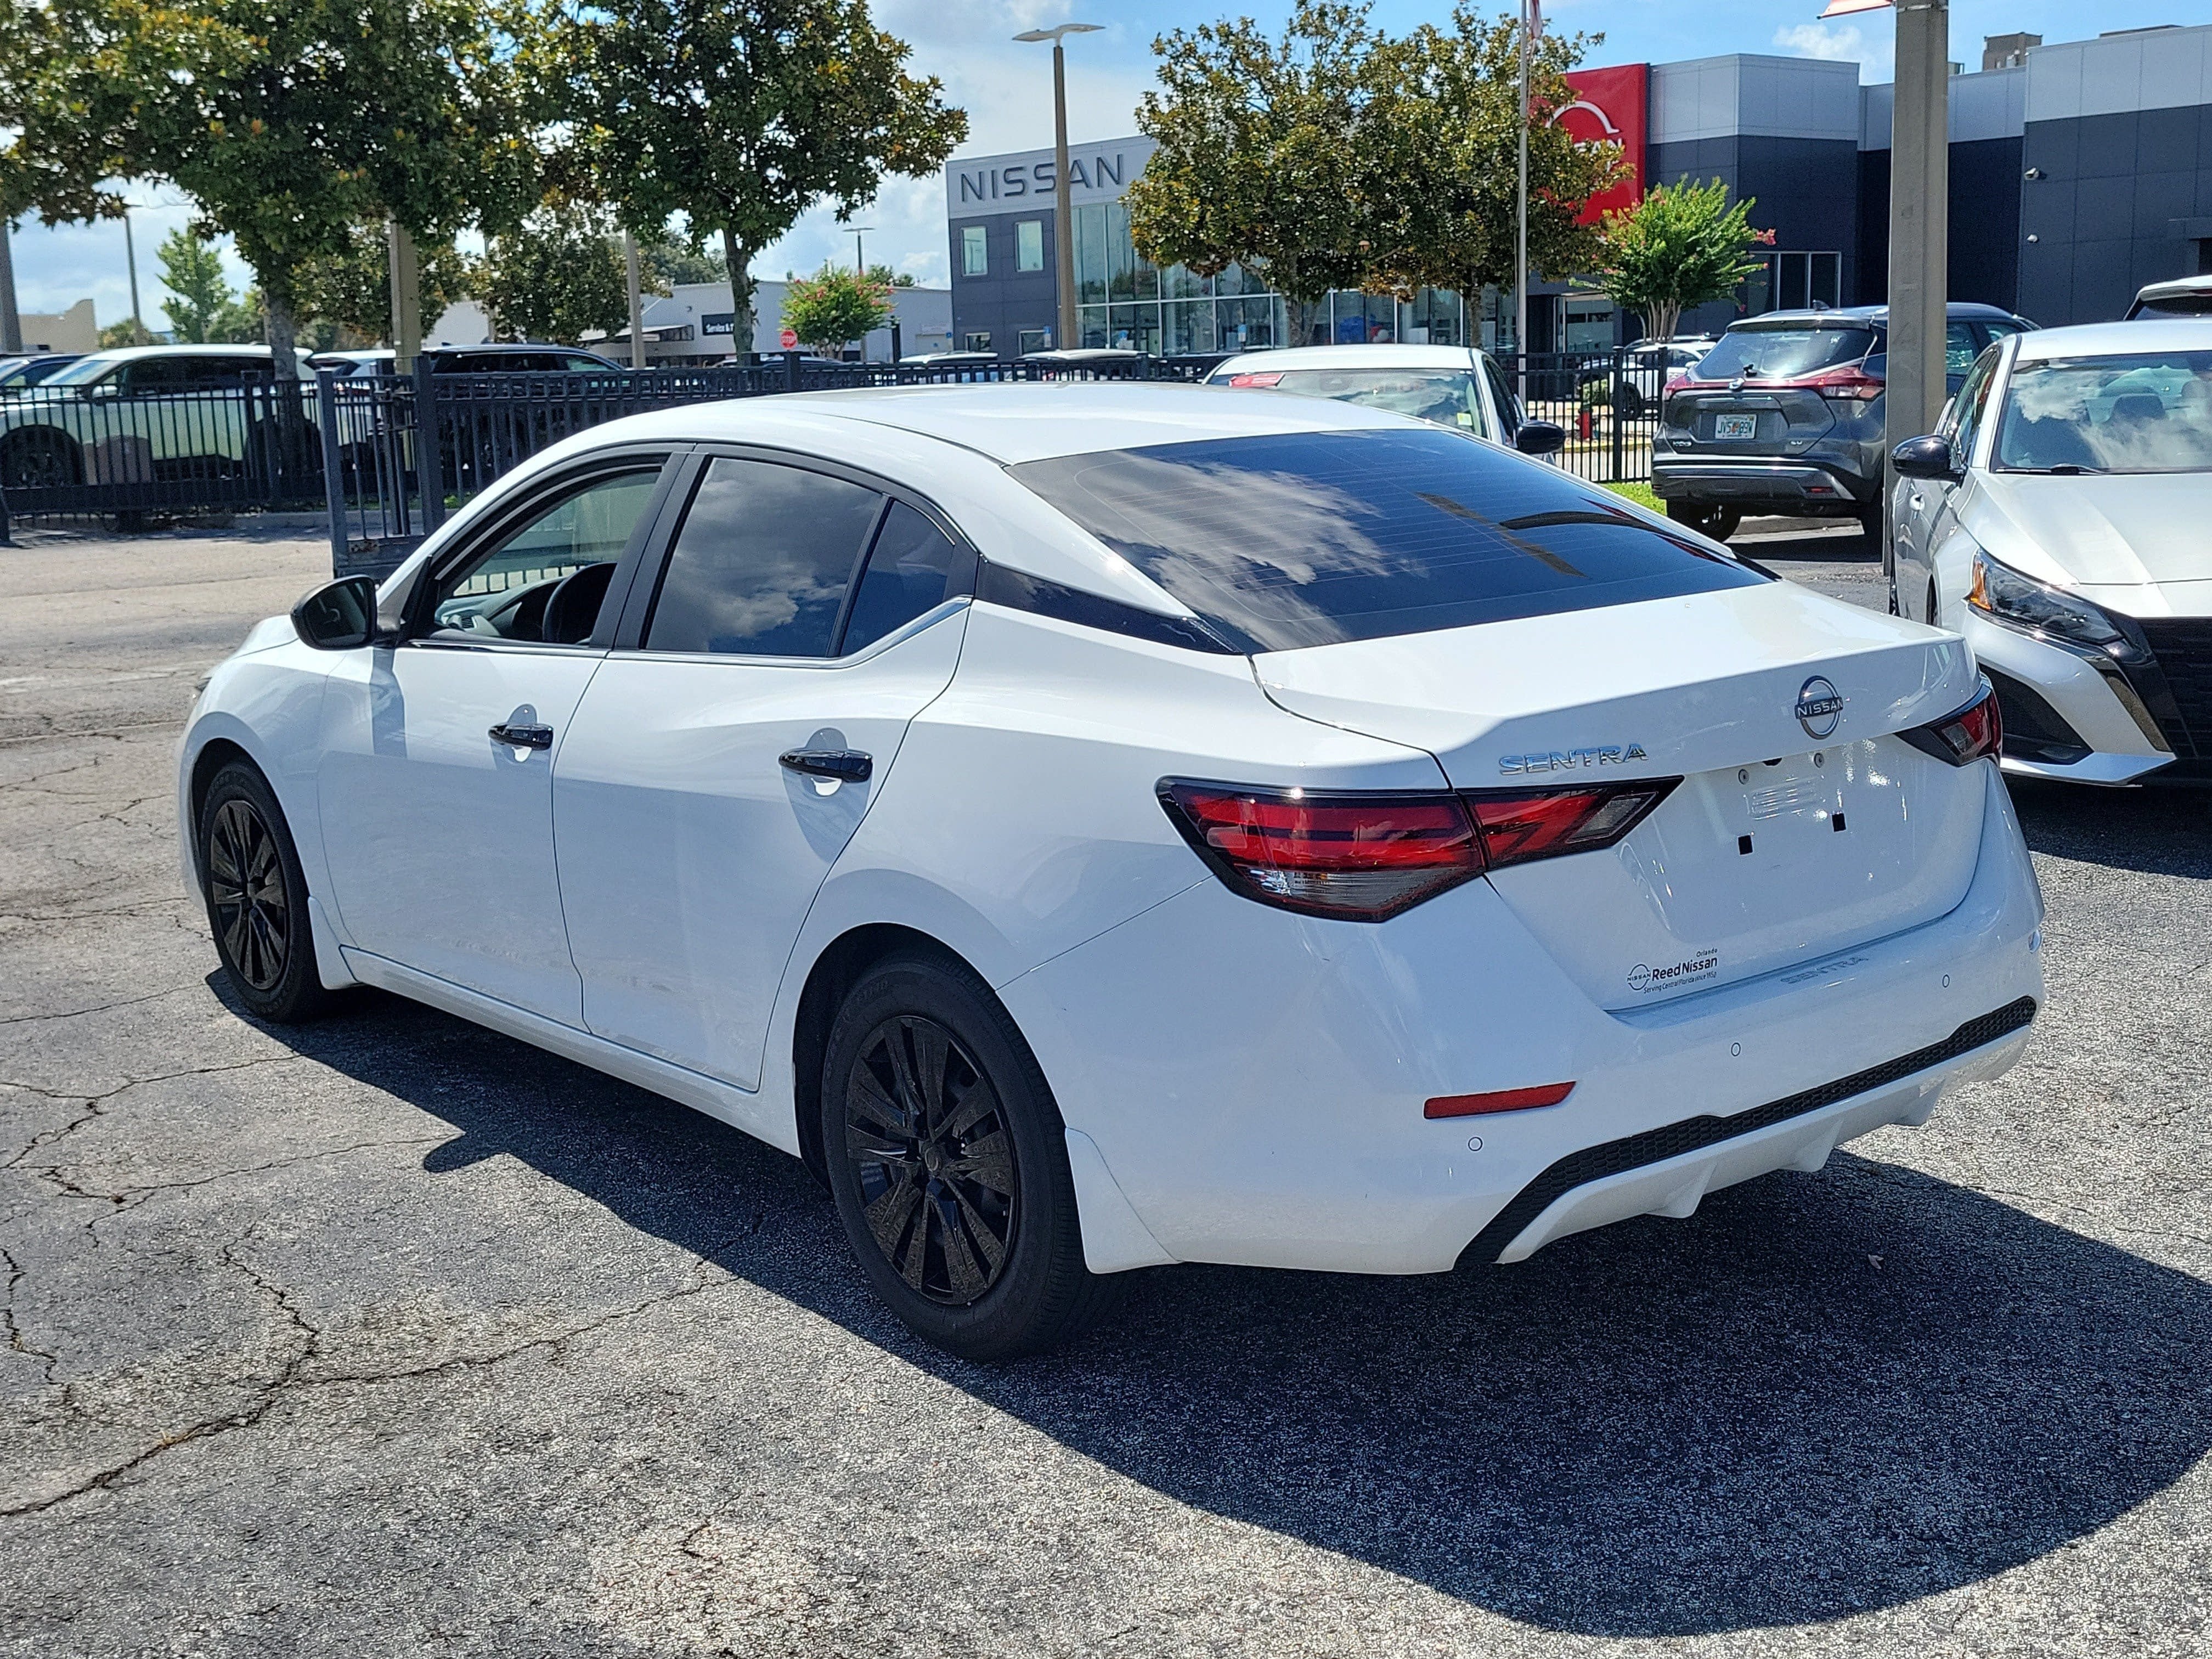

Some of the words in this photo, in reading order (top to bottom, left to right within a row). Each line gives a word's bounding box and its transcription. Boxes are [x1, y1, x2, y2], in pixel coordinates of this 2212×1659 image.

[961, 154, 1122, 202] NISSAN
[1797, 699, 1843, 716] NISSAN
[1499, 743, 1648, 775] SENTRA
[1696, 947, 1718, 958] Orlando
[1627, 972, 1651, 982] NISSAN
